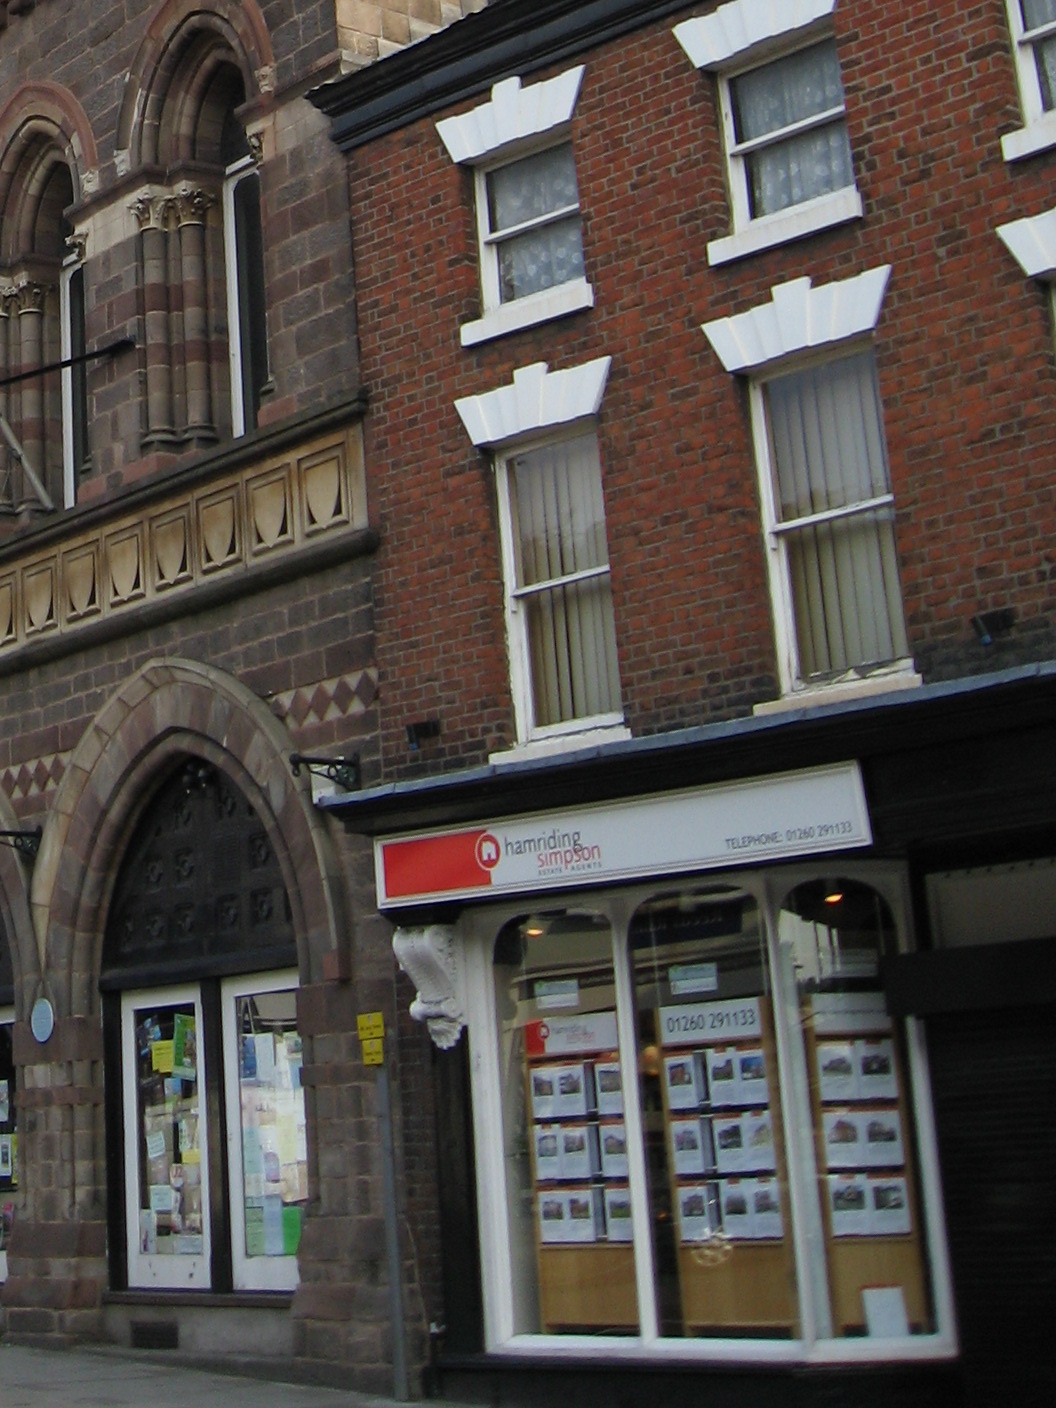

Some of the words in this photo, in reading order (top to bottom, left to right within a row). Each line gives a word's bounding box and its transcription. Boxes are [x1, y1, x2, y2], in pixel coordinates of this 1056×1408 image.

[504, 829, 581, 855] hamriding
[725, 831, 782, 849] TELEPHONE:
[786, 827, 815, 841] 01260
[817, 821, 852, 837] 291133
[537, 844, 601, 870] simpson
[666, 1015, 705, 1034] 01260
[709, 1008, 756, 1028] 291133
